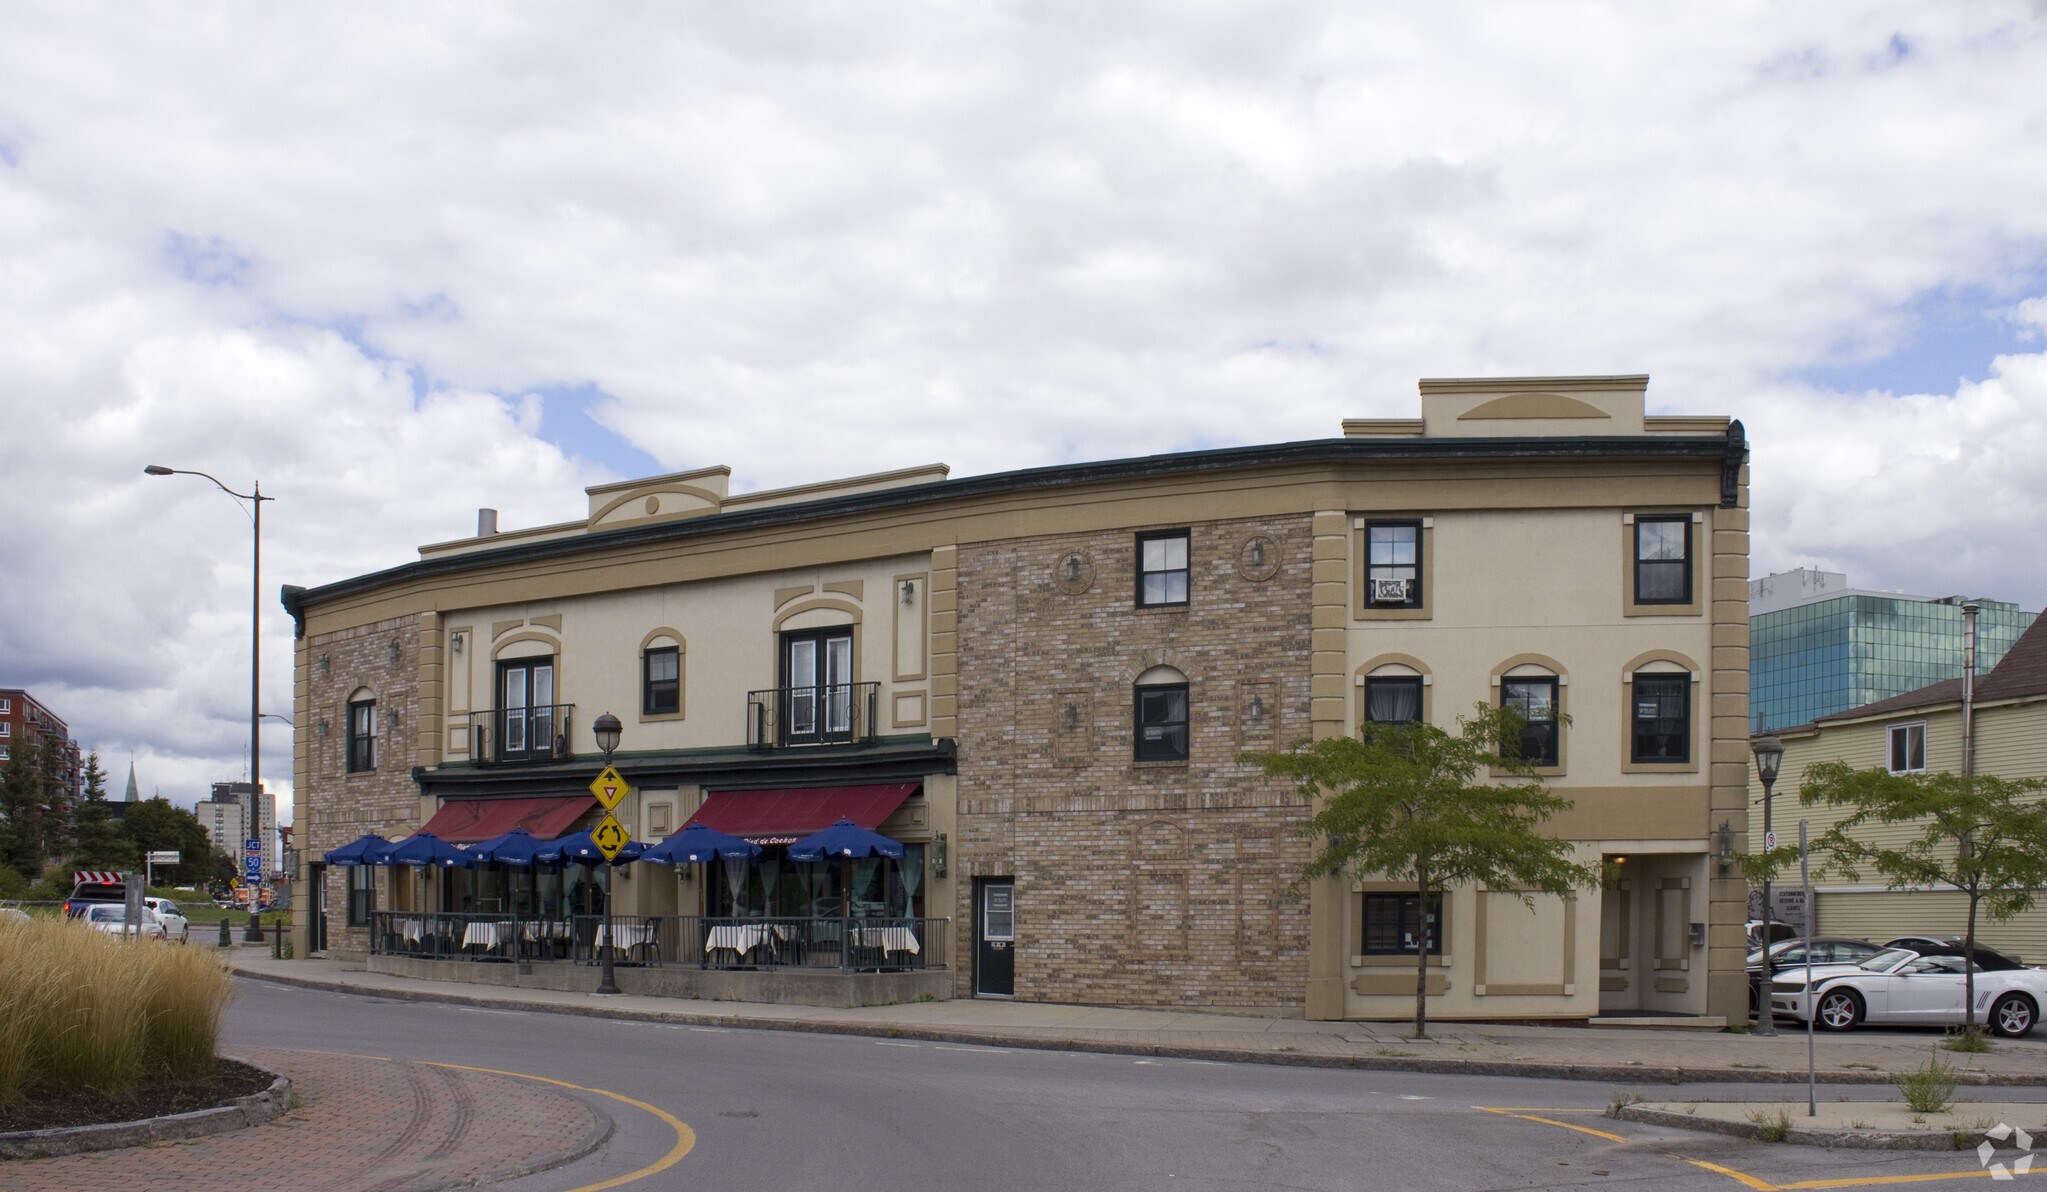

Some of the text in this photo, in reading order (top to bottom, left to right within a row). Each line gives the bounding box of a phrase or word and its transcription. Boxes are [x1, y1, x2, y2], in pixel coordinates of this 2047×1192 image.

[247, 841, 261, 849] JCT
[760, 837, 769, 845] de
[769, 836, 797, 844] Cochon
[248, 857, 259, 867] 50
